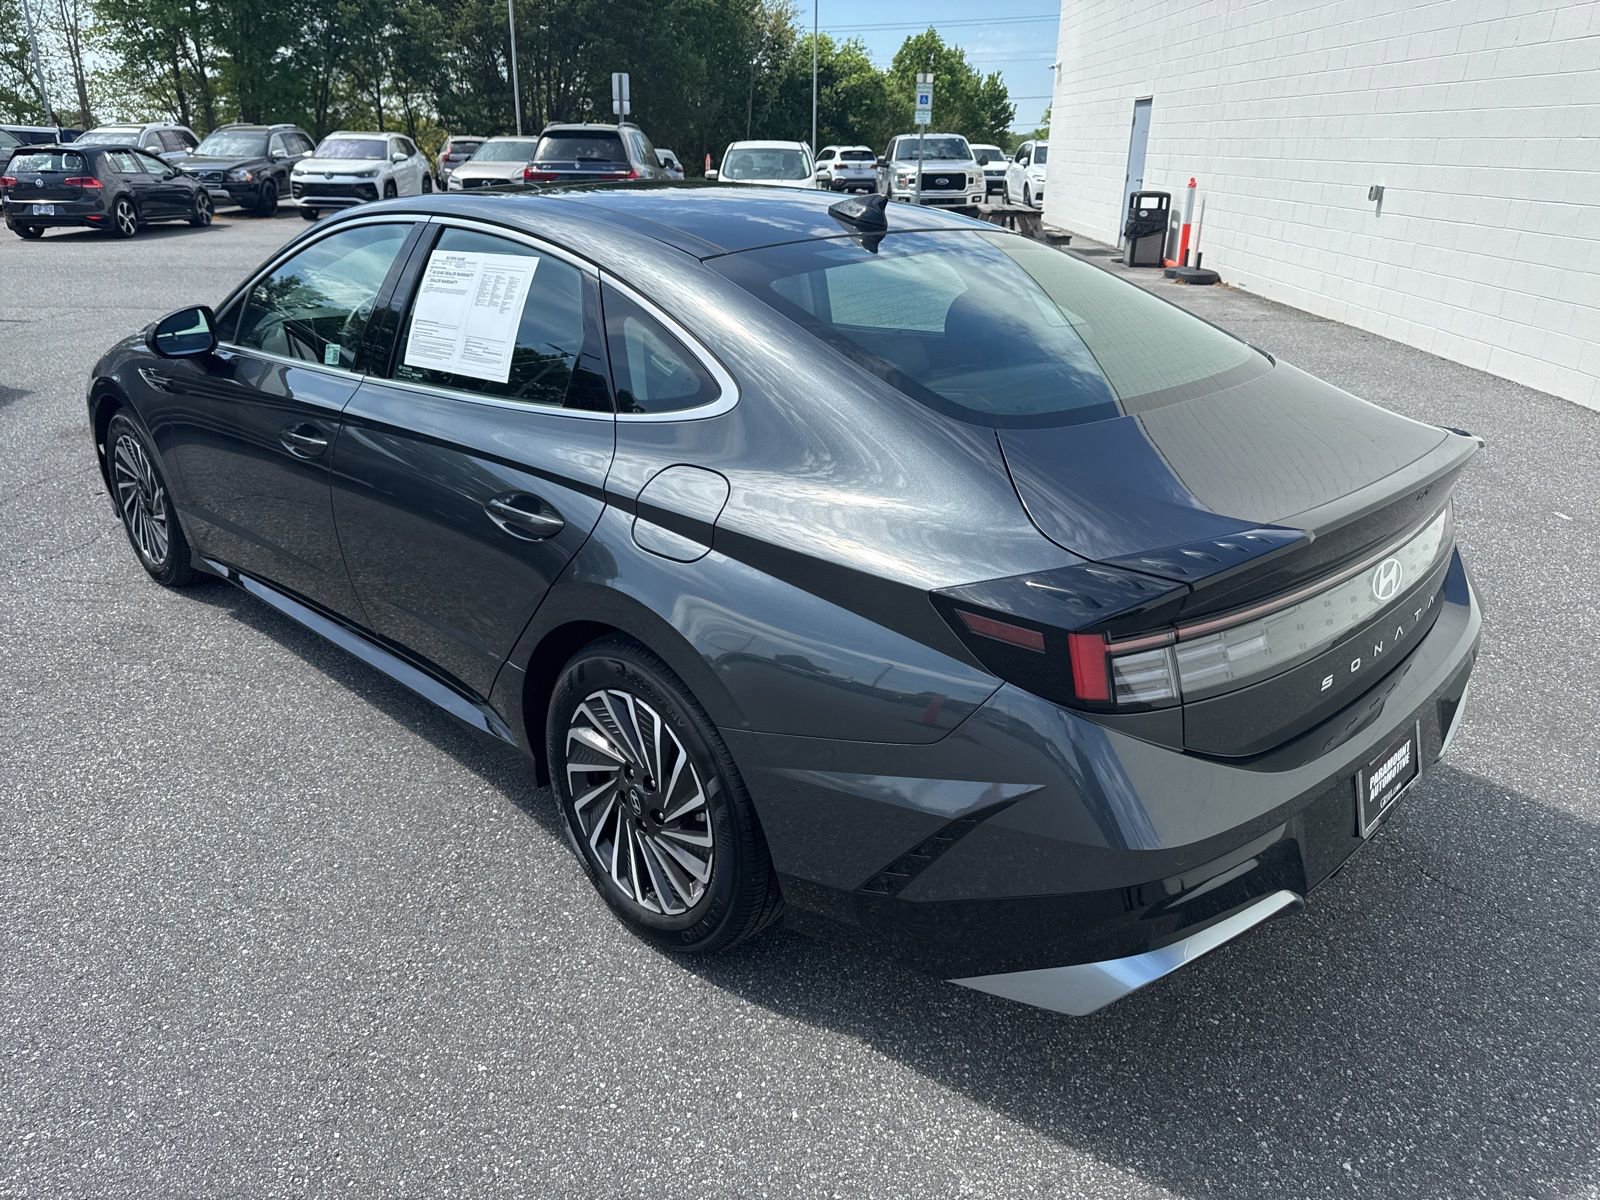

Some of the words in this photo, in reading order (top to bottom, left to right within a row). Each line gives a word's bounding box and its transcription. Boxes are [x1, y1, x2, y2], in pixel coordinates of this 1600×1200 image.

[1320, 595, 1435, 692] SONATA
[1369, 739, 1411, 790] PARAMOUNT
[1369, 752, 1410, 802] AUTOMOTIVE
